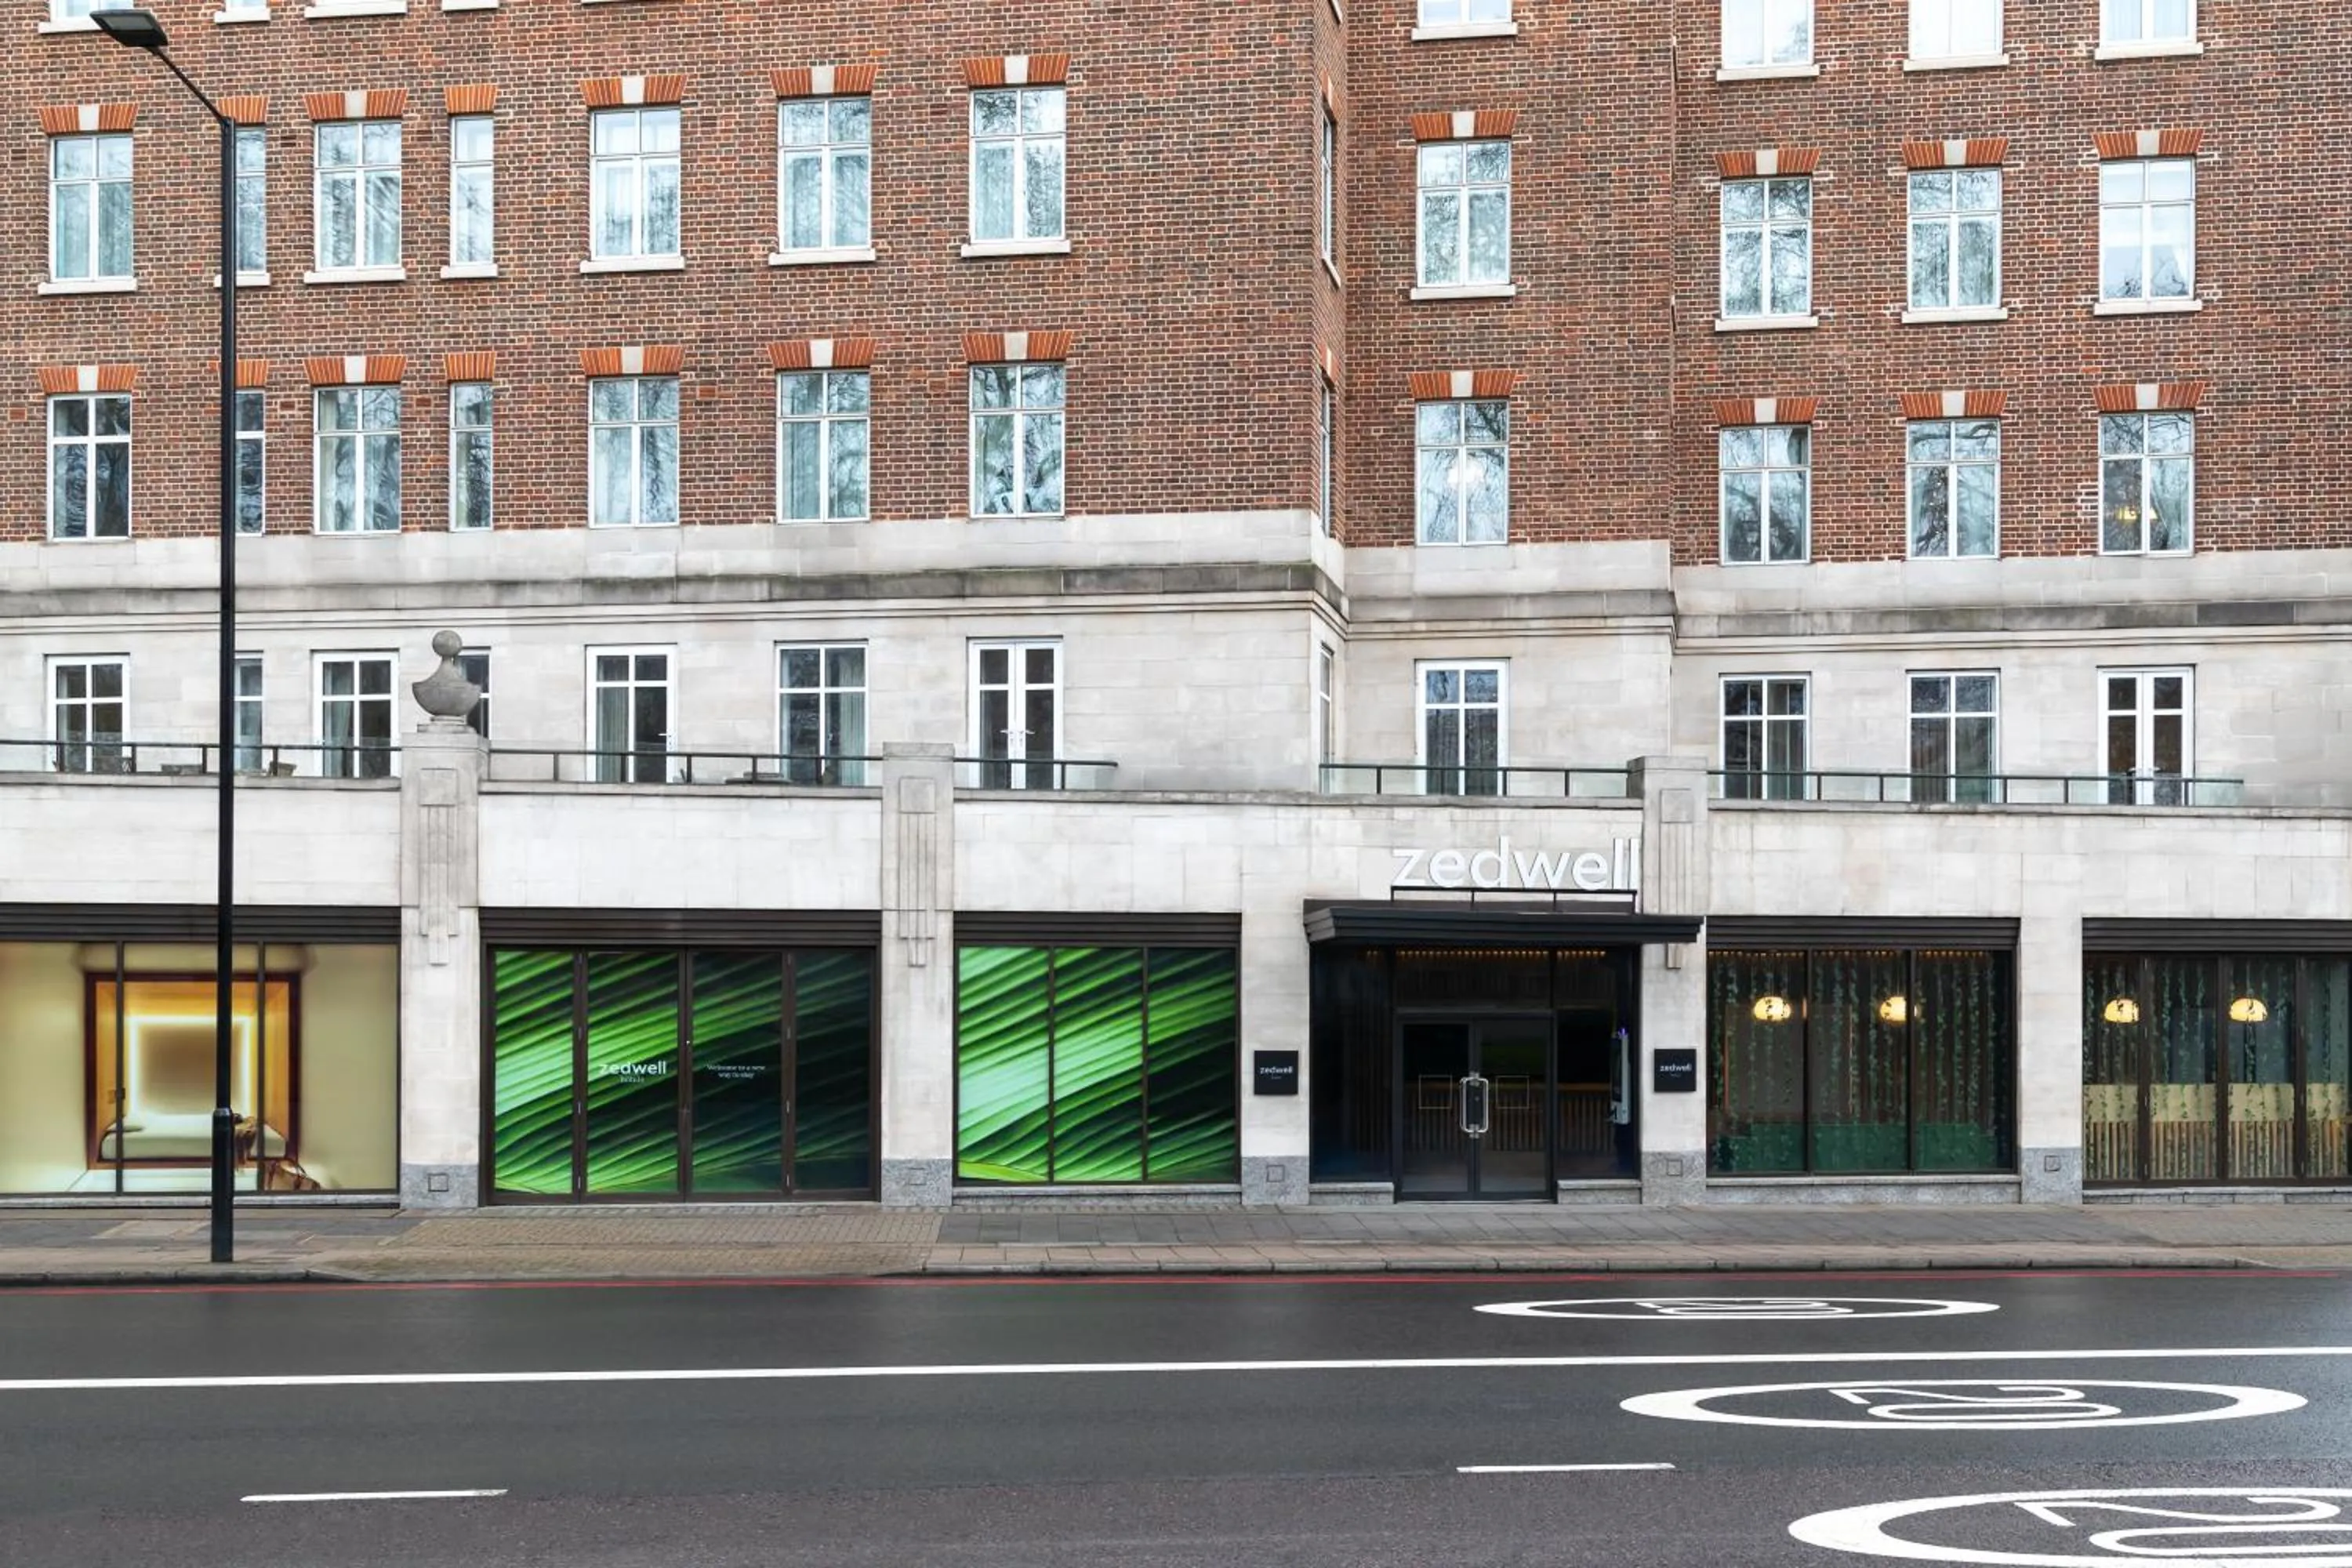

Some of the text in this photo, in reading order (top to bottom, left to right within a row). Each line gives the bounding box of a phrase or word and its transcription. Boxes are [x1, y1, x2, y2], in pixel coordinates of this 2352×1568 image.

[1391, 835, 1640, 890] zedwell
[599, 1061, 666, 1075] zedwell
[1828, 1386, 2122, 1421] 20
